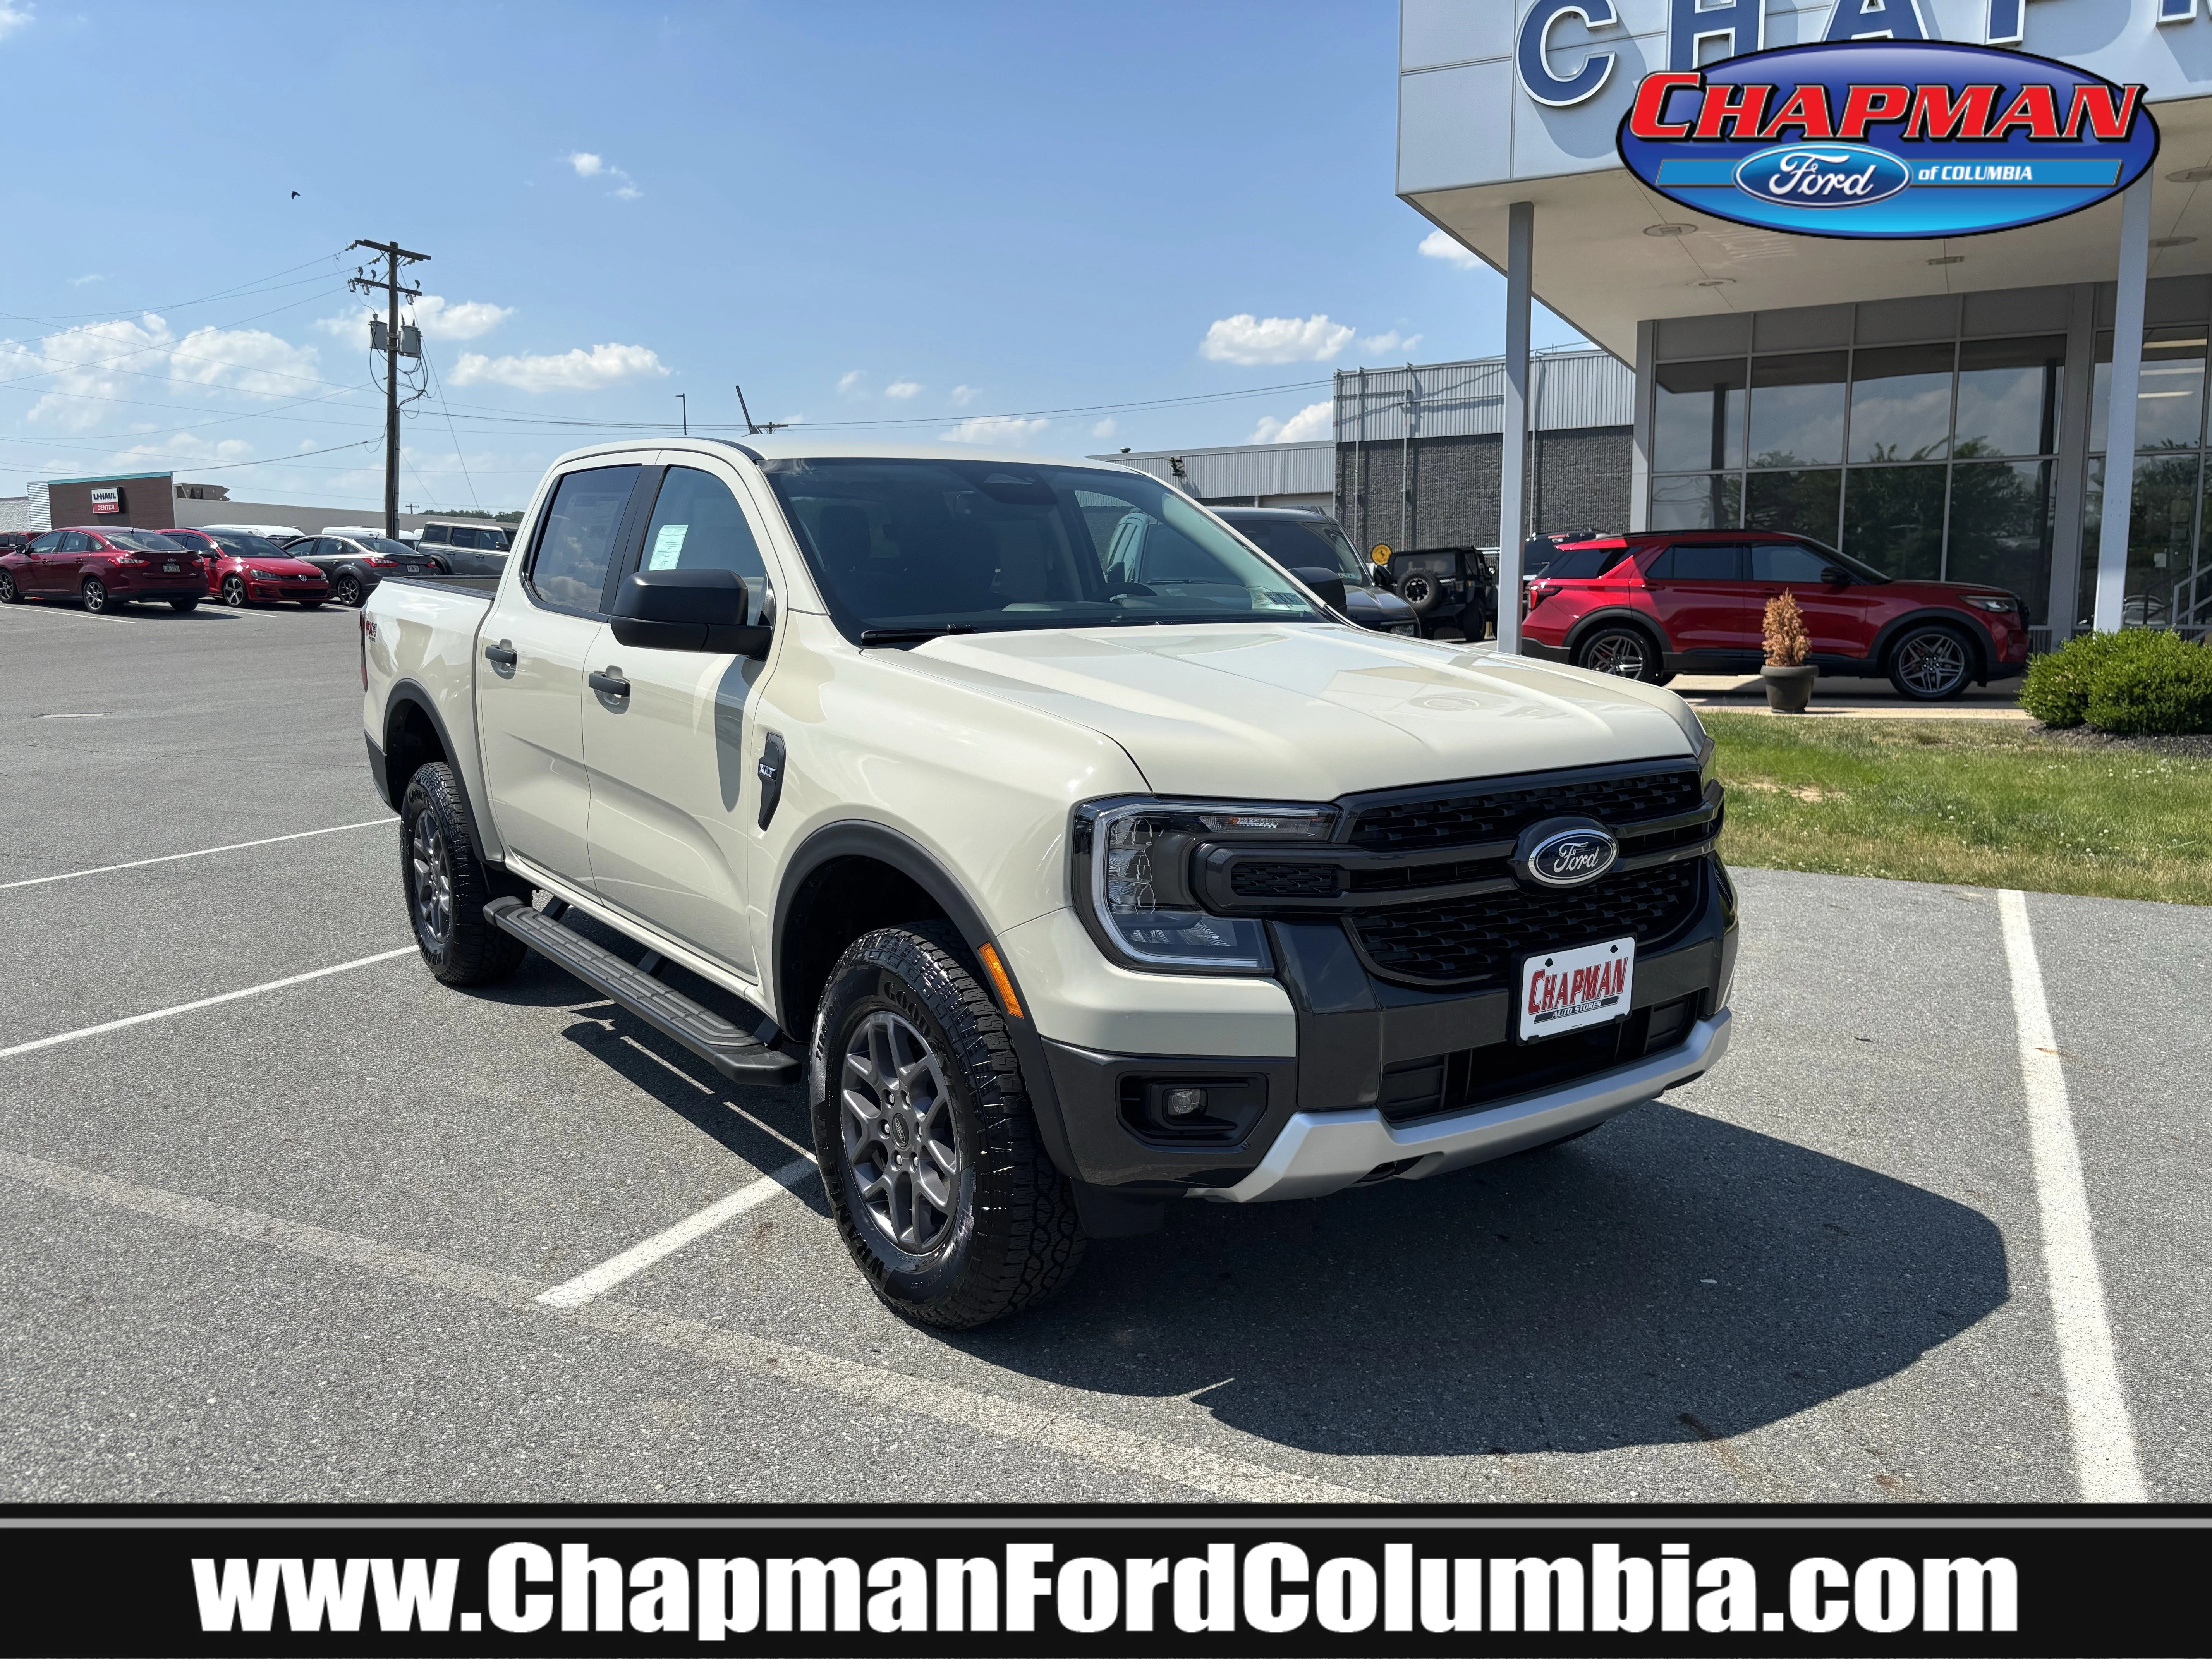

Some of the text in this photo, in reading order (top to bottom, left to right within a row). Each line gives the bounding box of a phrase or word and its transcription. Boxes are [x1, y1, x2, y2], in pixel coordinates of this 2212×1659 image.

[366, 620, 377, 637] FX4
[759, 763, 776, 778] XLT
[1553, 841, 1601, 873] Ford
[1528, 957, 1628, 1015] CHAPMAN
[1552, 1000, 1602, 1018] AUTO STORES
